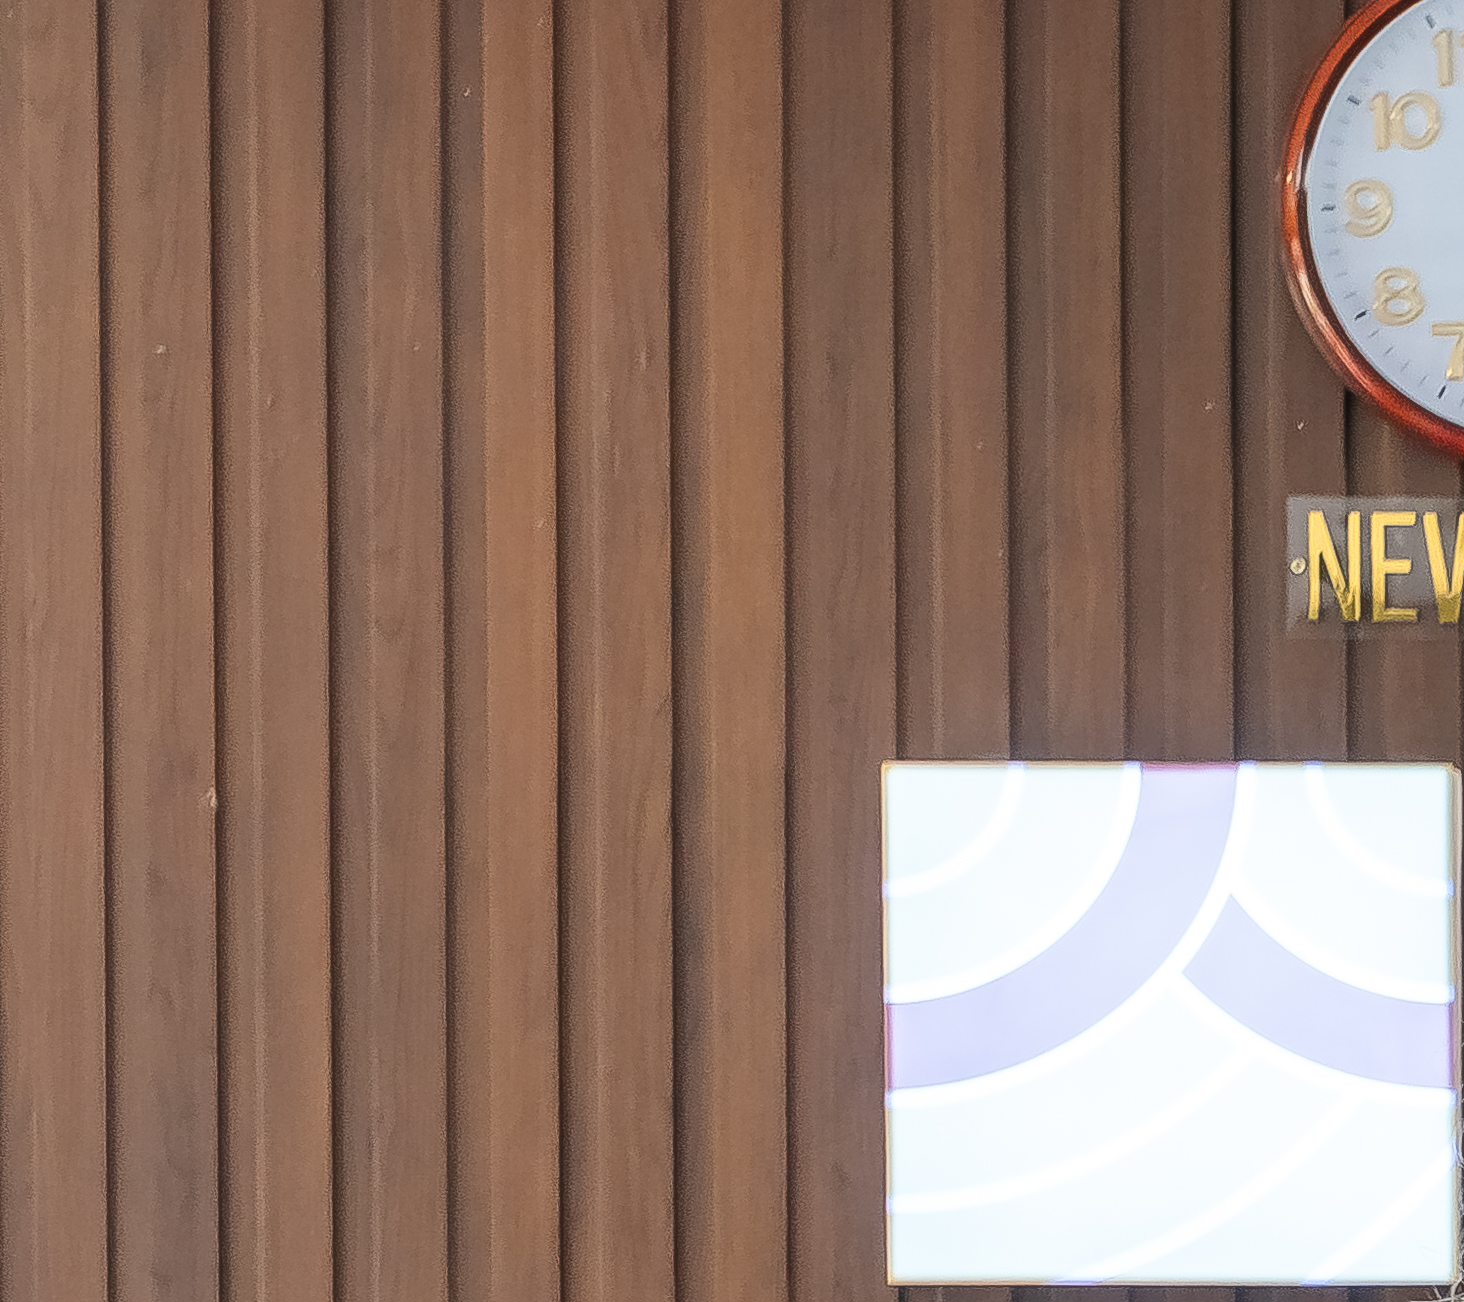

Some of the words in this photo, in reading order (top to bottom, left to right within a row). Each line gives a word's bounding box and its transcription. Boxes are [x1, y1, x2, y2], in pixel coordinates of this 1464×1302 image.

[1369, 91, 1441, 151] 10
[1344, 180, 1393, 238] 9
[1373, 267, 1425, 326] 8
